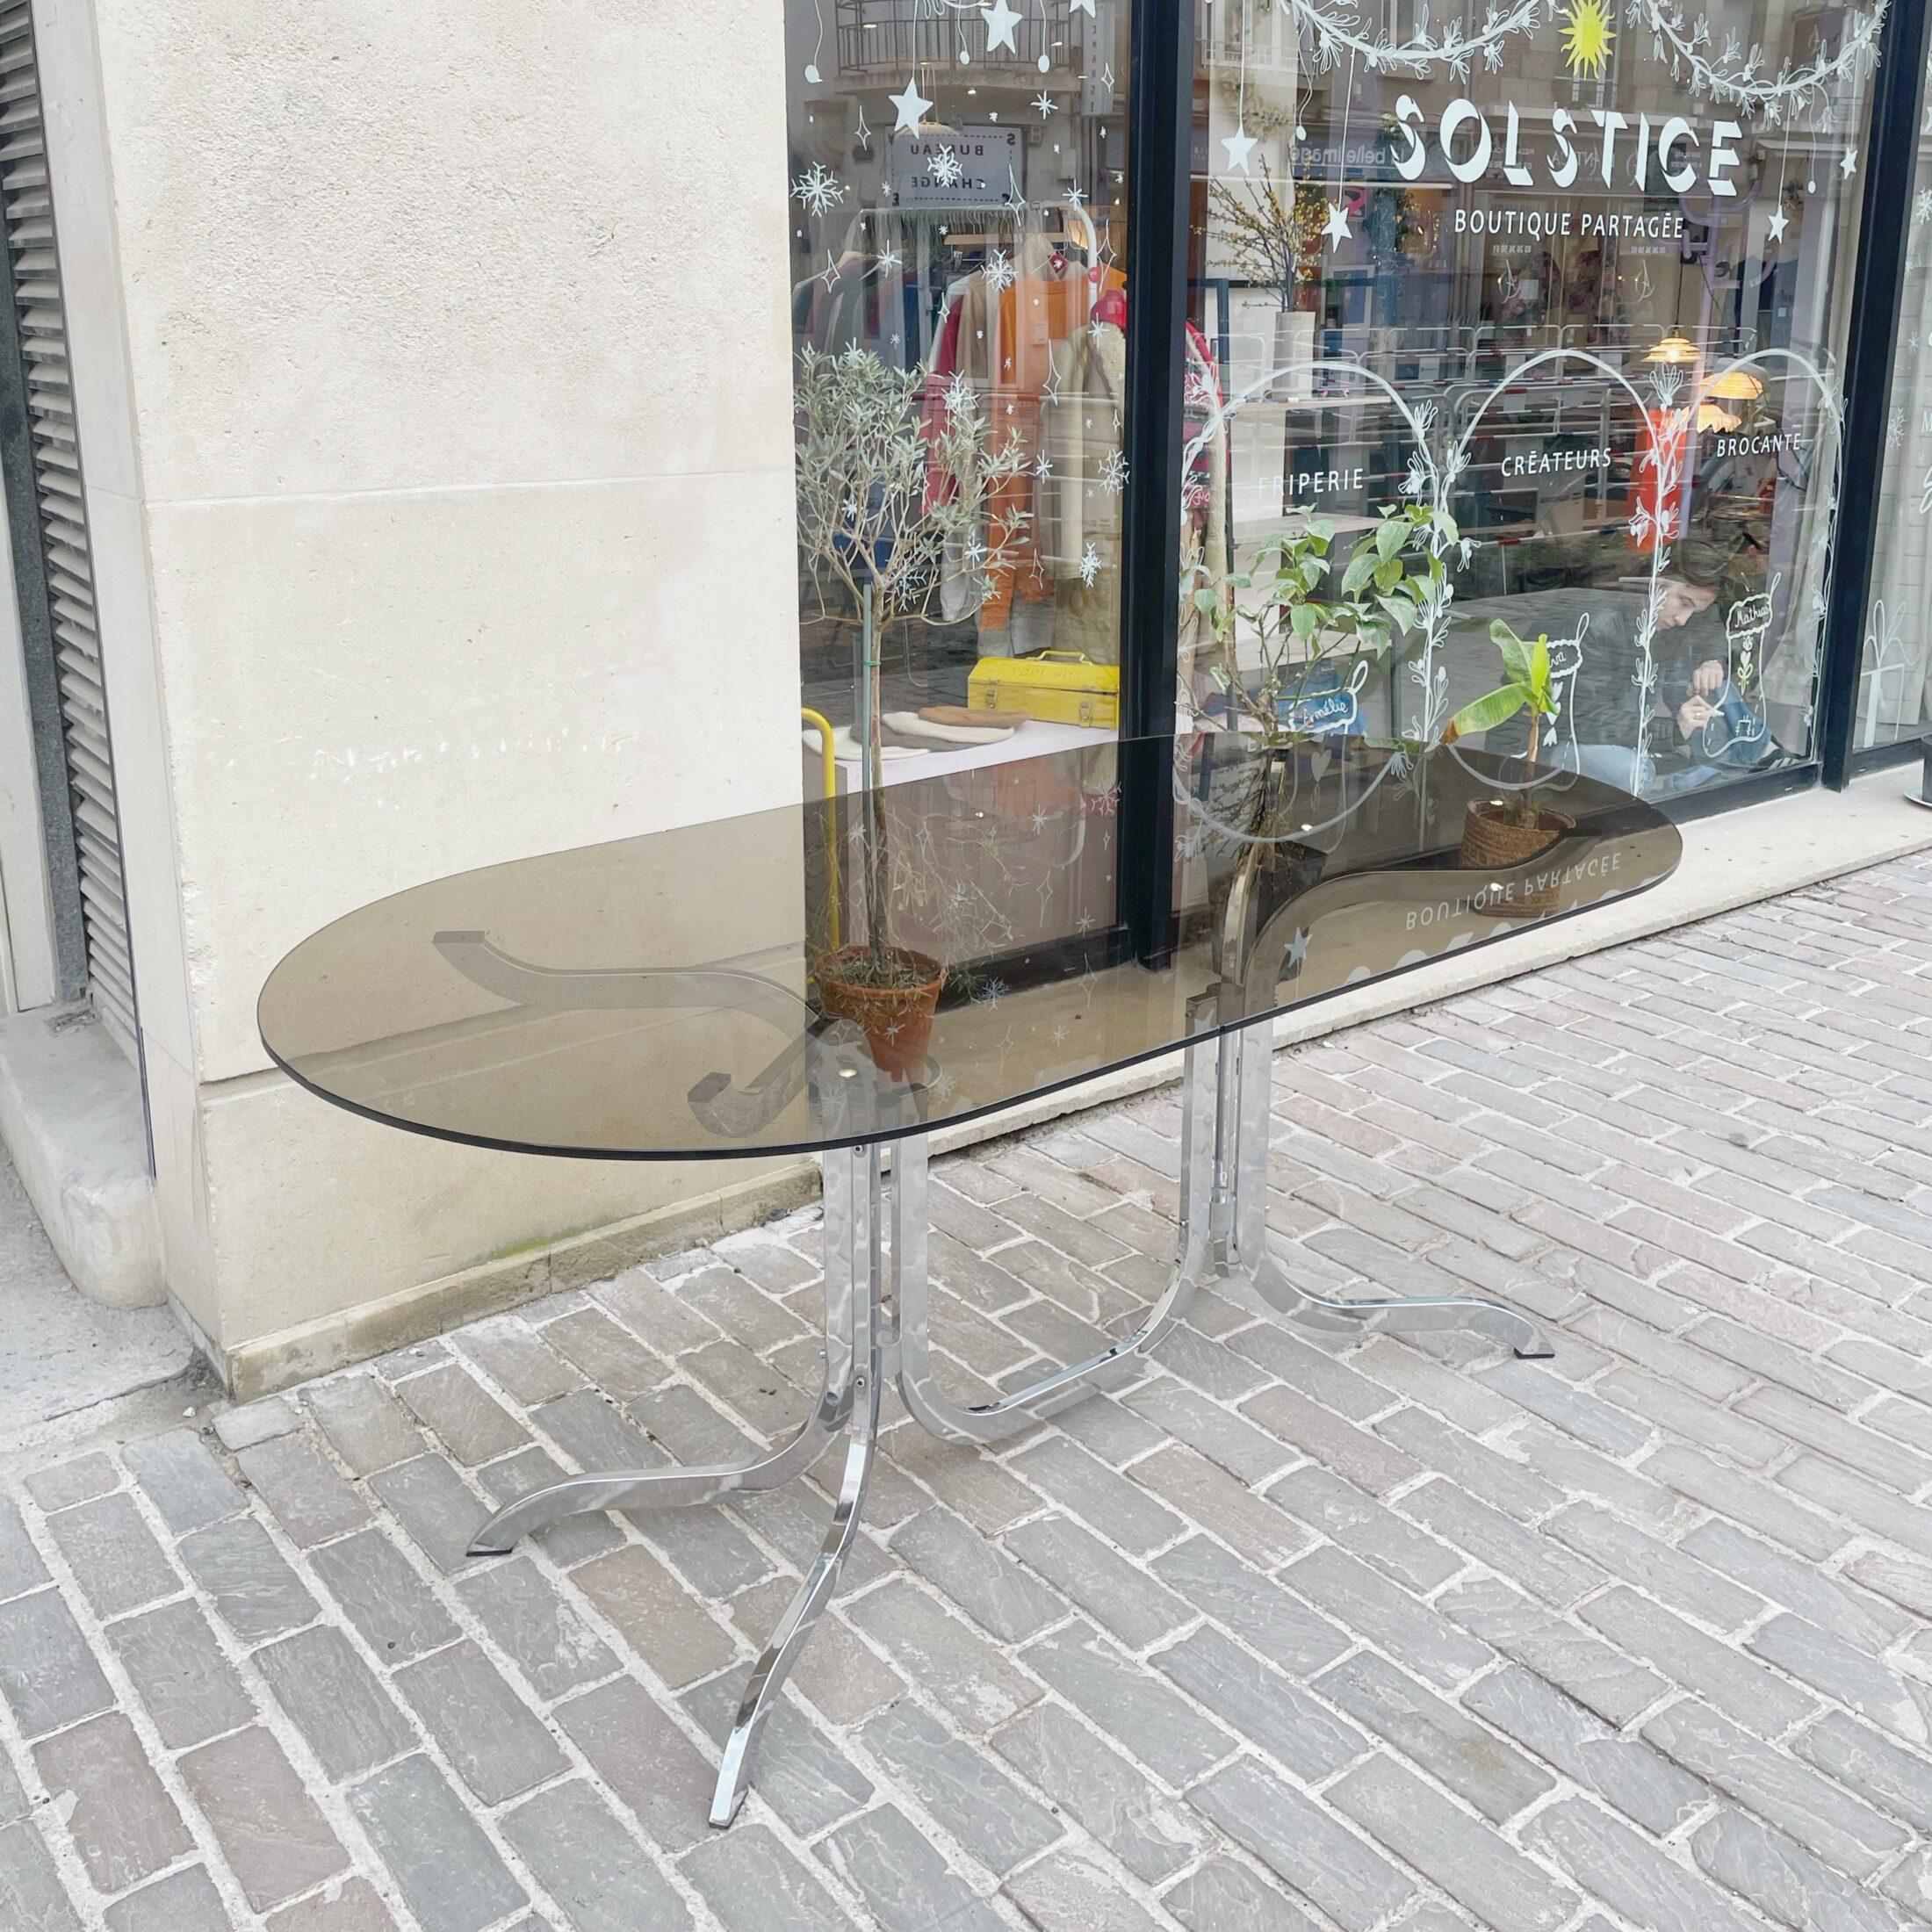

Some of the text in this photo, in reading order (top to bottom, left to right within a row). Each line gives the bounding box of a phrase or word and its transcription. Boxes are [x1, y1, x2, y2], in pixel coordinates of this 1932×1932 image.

[1392, 94, 1744, 197] SOLSTICE
[1454, 209, 1572, 242] BOUTIQUE
[1717, 433, 1801, 458] BROCANTE
[1258, 467, 1364, 499] FRIPERIE
[1734, 604, 1770, 628] Mathias
